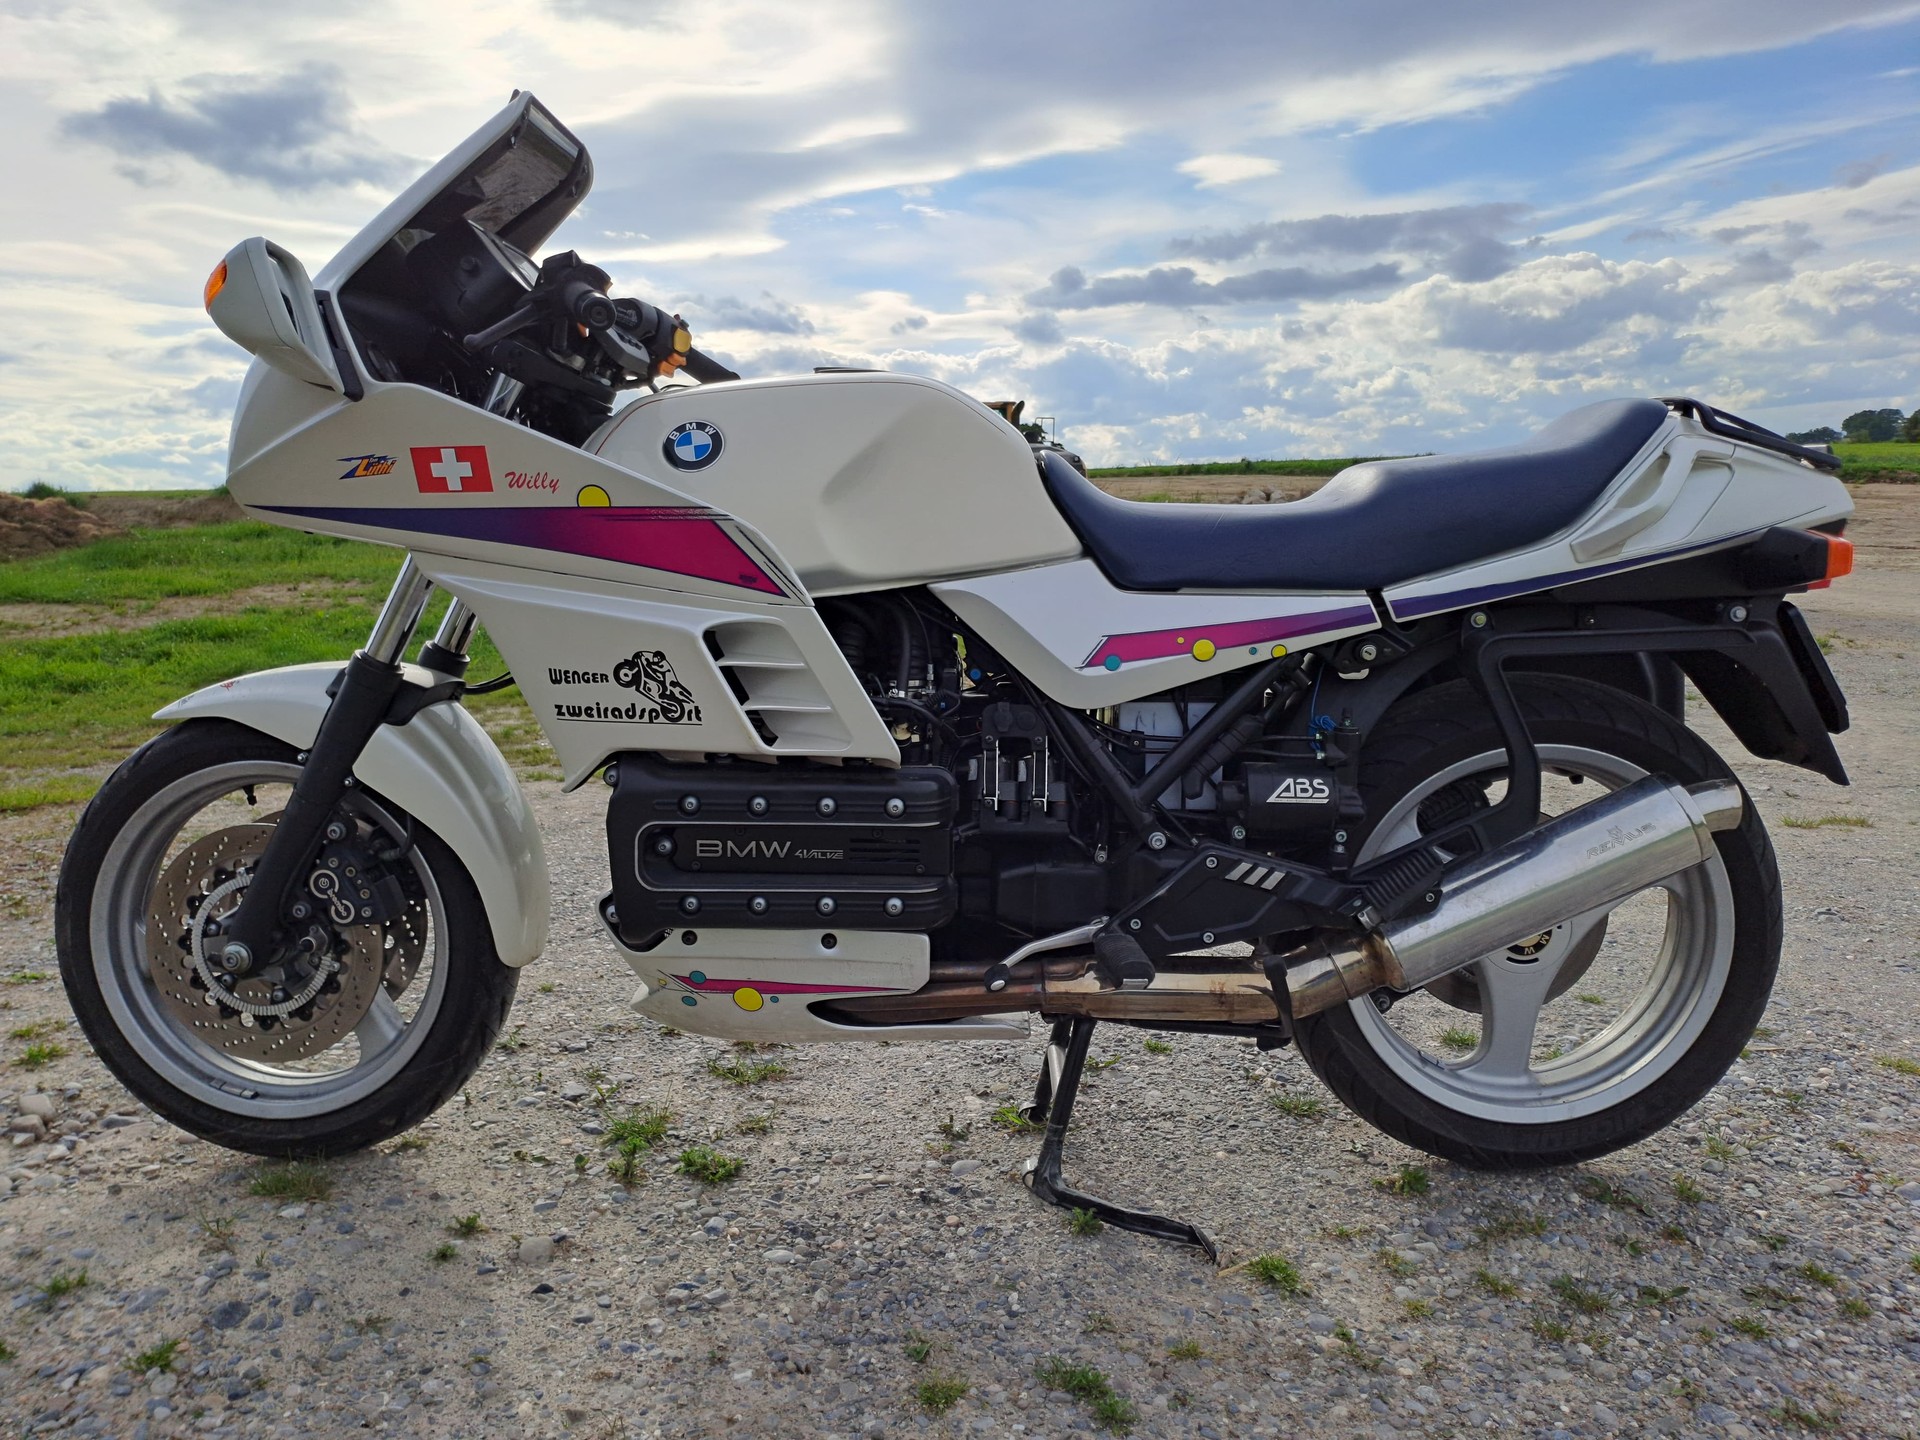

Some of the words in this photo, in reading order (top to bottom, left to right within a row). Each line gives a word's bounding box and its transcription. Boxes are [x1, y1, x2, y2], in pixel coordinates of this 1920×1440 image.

[669, 422, 717, 440] BMW
[504, 471, 560, 494] Willy
[548, 667, 609, 685] WENGER
[1267, 778, 1330, 802] ABS
[696, 840, 791, 858] BMW
[1586, 823, 1657, 859] REMUS
[327, 888, 348, 916] brembo
